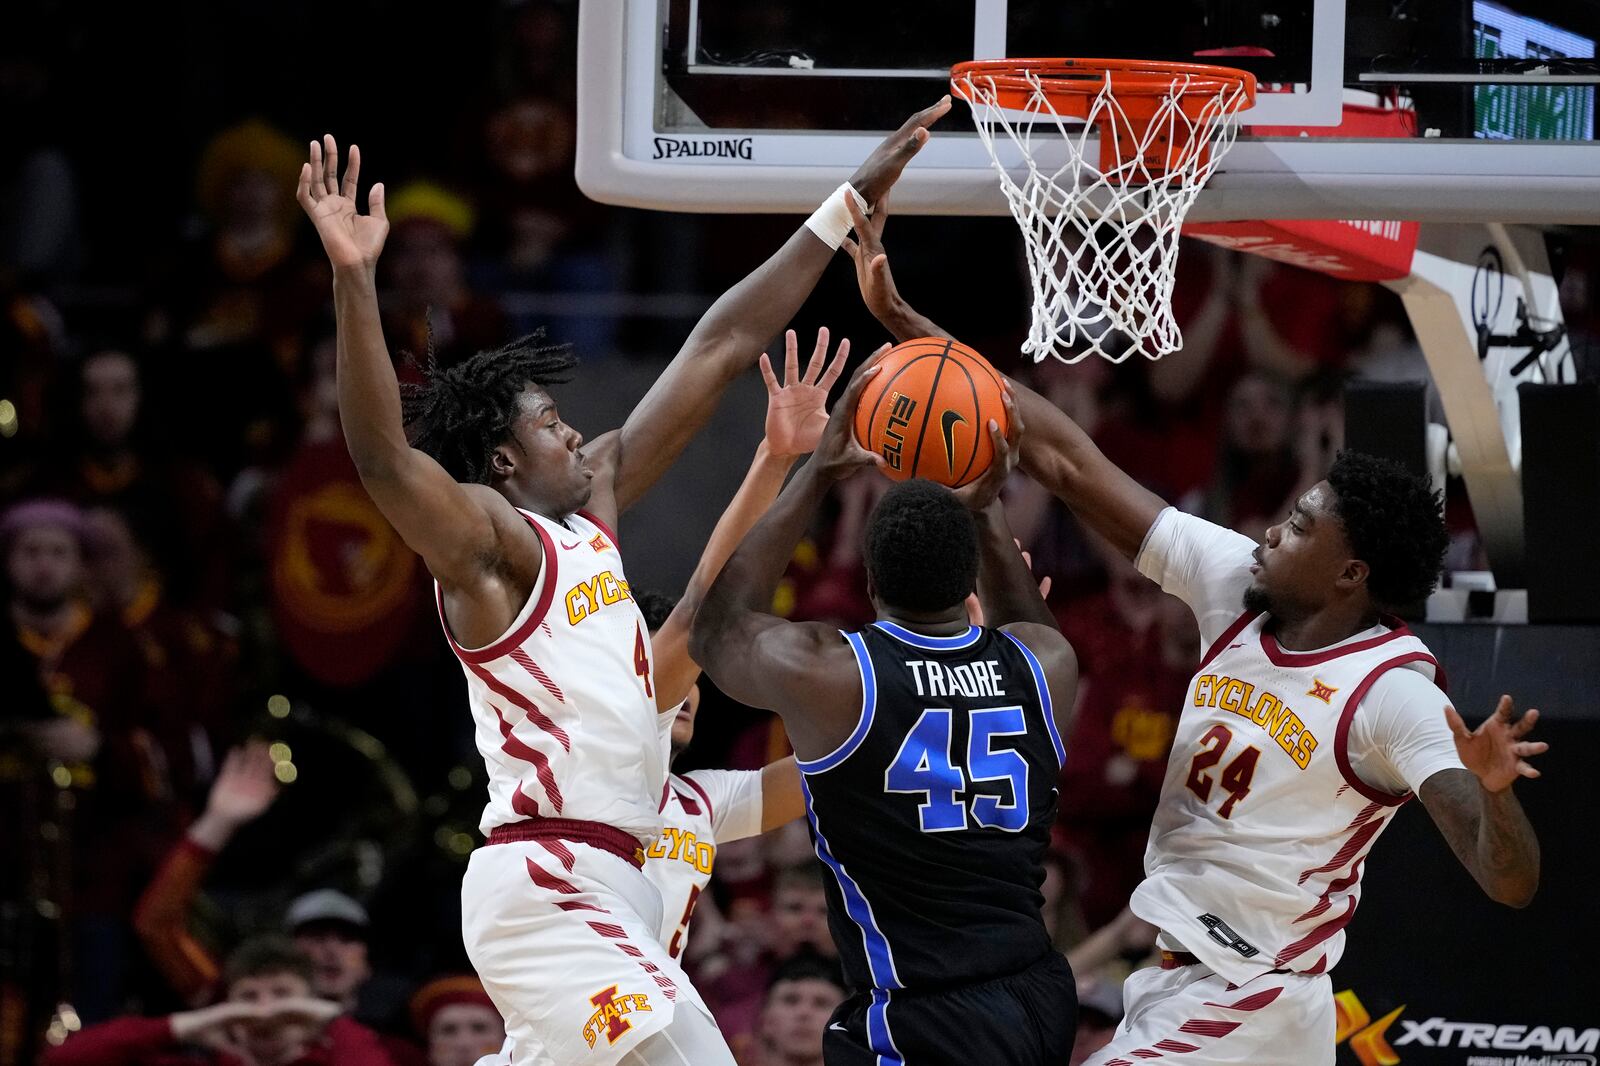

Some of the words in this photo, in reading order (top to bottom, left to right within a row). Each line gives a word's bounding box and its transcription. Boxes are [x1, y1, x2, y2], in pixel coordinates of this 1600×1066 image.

[653, 137, 753, 160] SPALDING
[883, 393, 917, 473] ELITE
[633, 618, 653, 698] 4
[905, 660, 1006, 698] TRAORE
[1193, 674, 1319, 771] CYCLONES
[884, 705, 1030, 833] 45
[1185, 722, 1261, 820] 24
[582, 993, 653, 1050] STATE
[1394, 1016, 1600, 1053] XTREAM
